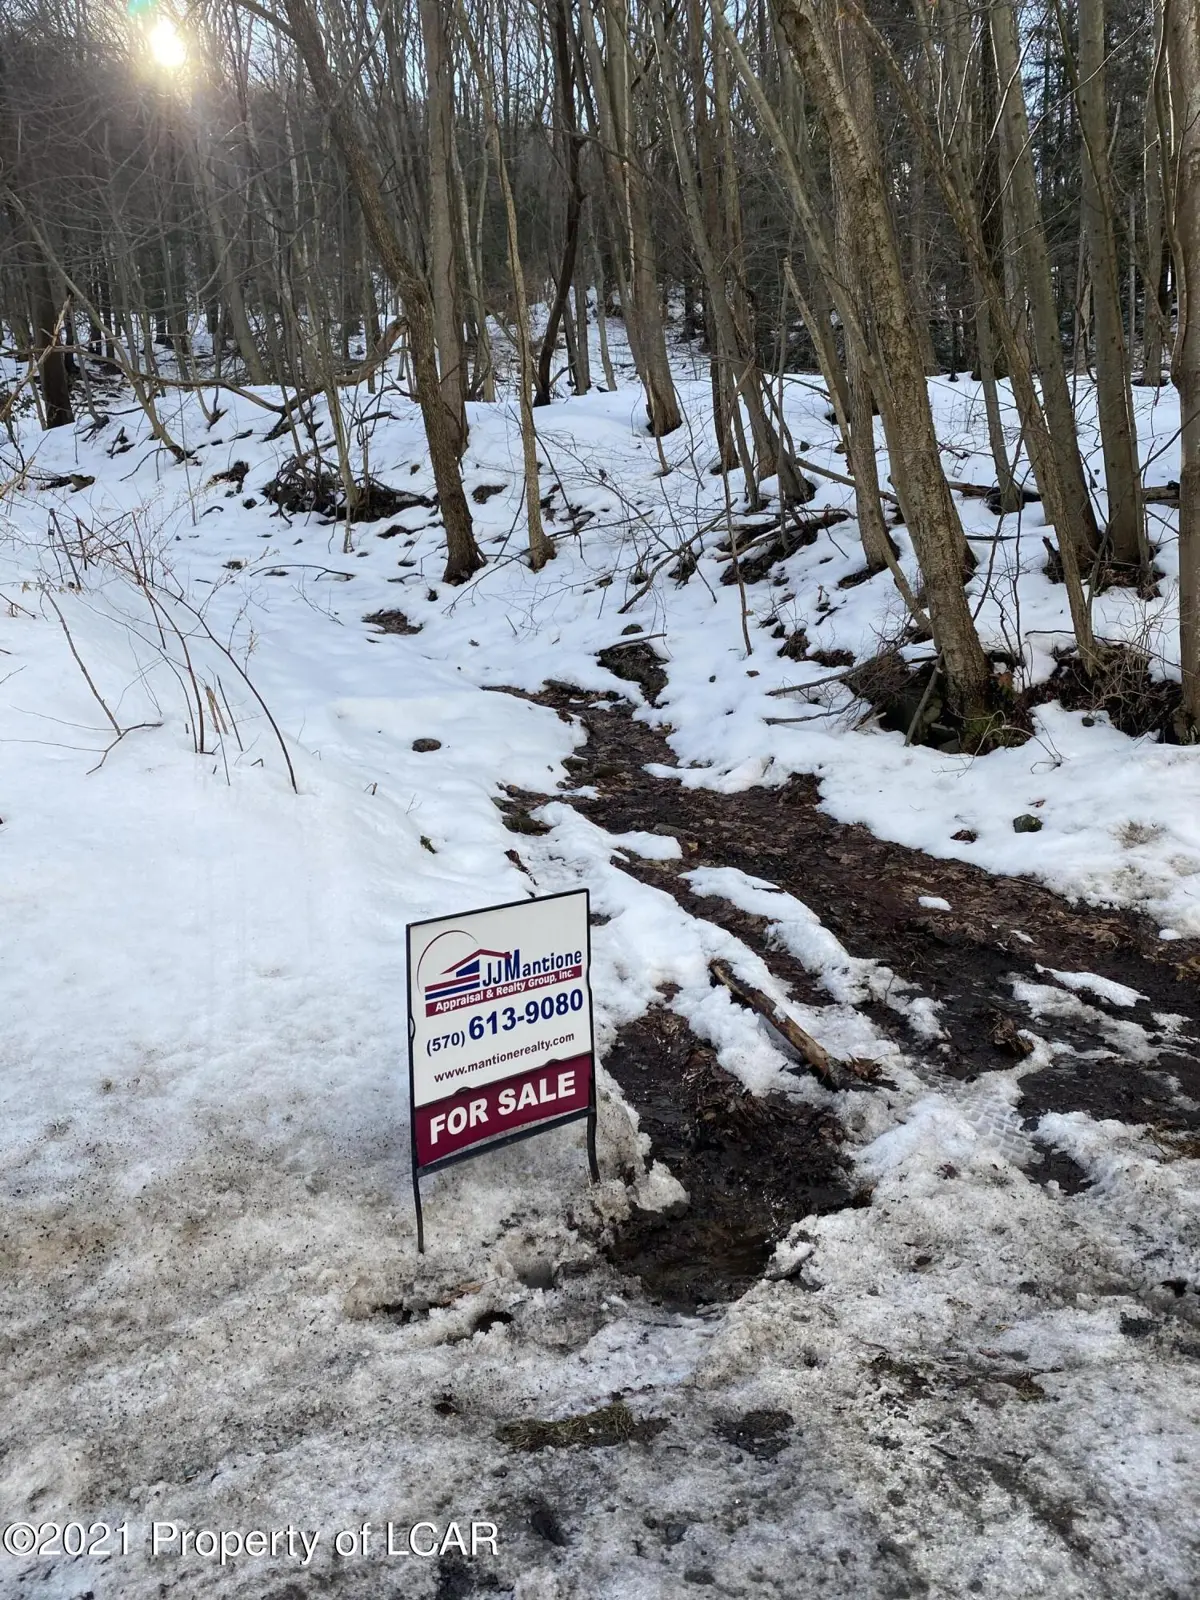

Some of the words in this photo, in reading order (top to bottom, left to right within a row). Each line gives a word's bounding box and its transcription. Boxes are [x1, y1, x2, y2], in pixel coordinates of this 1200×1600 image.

[427, 1030, 466, 1057] (570)
[469, 988, 583, 1040] 613-9080
[435, 992, 483, 1012] Appraisal
[486, 989, 494, 999] &
[496, 980, 526, 996] Realty
[528, 974, 557, 988] Group,
[434, 1032, 575, 1083] www.mantionerealty.com
[430, 1098, 489, 1146] FOR
[498, 1070, 576, 1116] SALE
